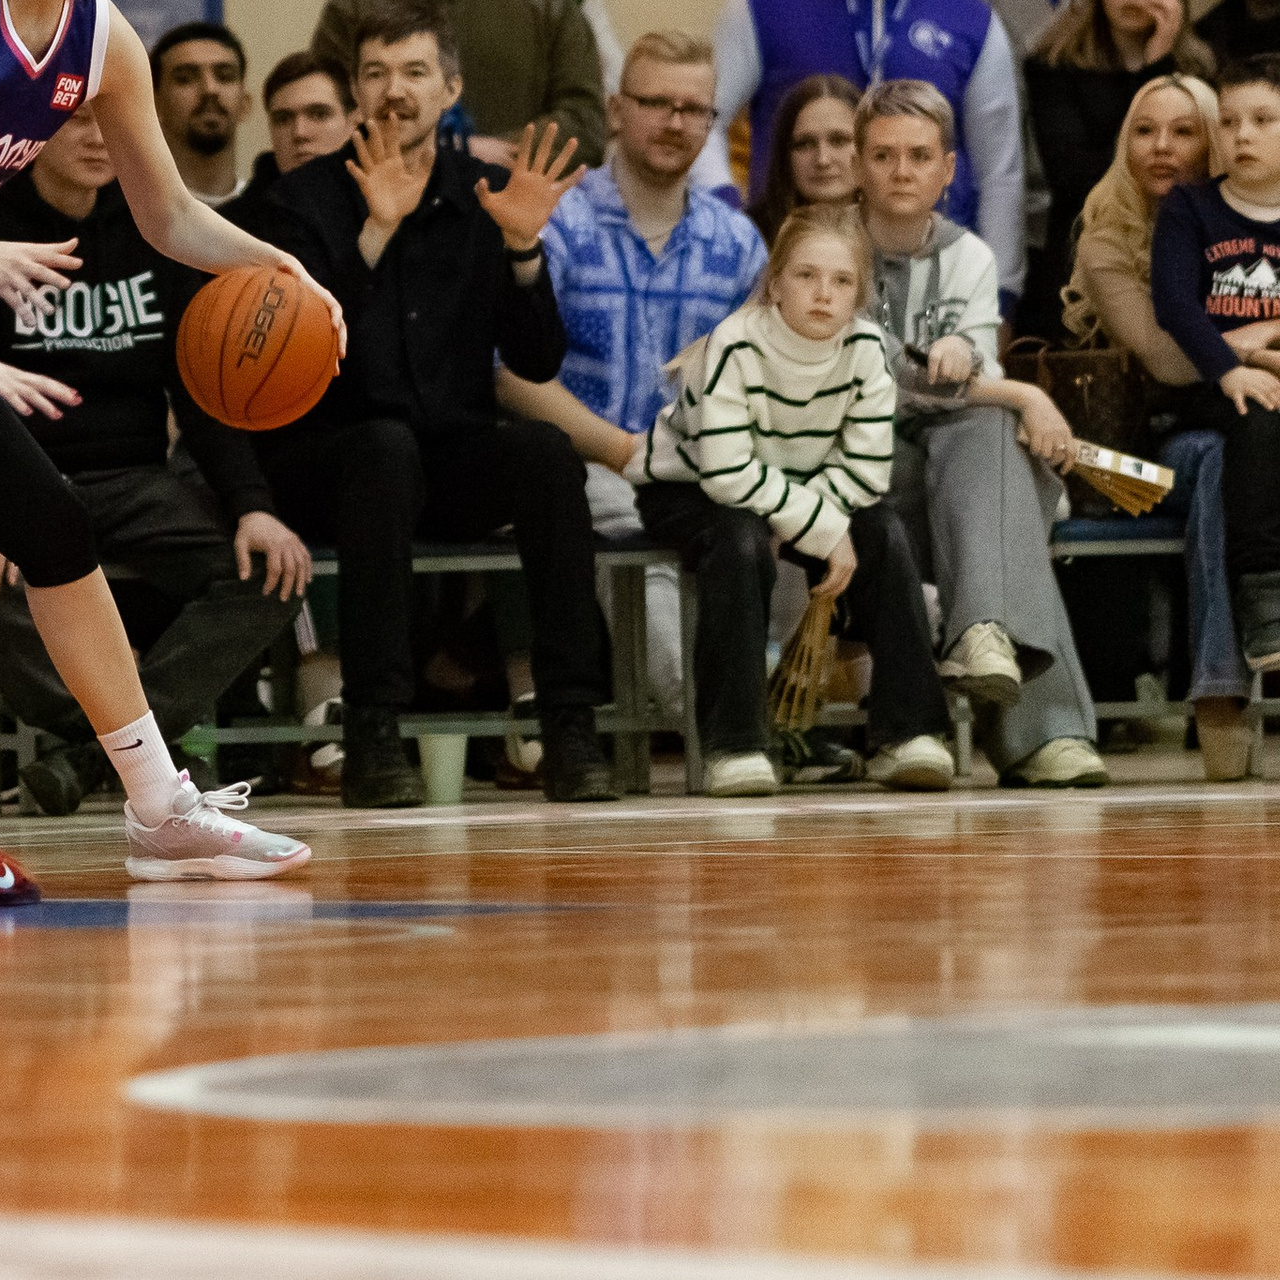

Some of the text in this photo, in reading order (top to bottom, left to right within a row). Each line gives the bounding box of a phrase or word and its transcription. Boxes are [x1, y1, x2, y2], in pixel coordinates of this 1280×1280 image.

[57, 76, 83, 92] FON
[52, 92, 78, 107] BET
[43, 332, 133, 352] PRODUCTION
